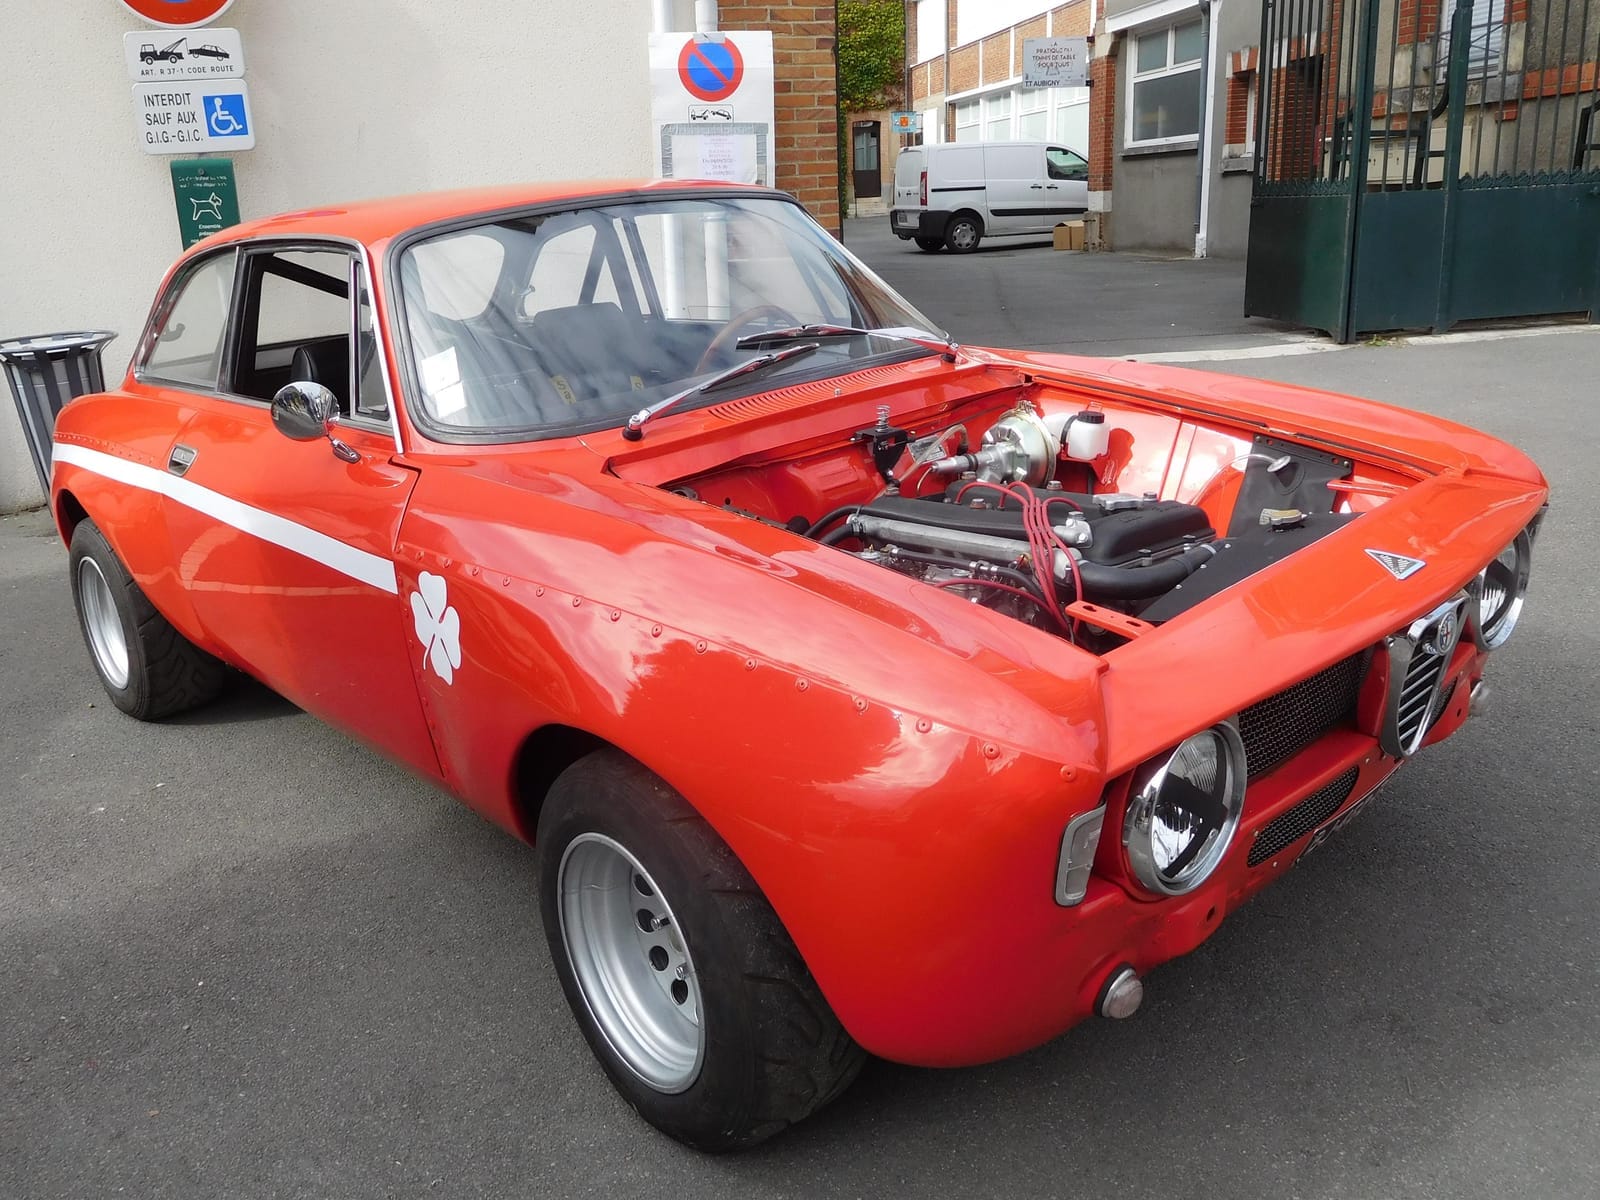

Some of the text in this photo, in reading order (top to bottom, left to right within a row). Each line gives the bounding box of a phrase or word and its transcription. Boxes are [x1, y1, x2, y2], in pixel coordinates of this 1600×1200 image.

[187, 66, 207, 74] CODE
[211, 65, 234, 73] ROUTE
[143, 93, 191, 107] INTERDIT
[145, 111, 198, 126] SAUF AUX
[145, 128, 204, 144] G.I.G.-G.I.C.
